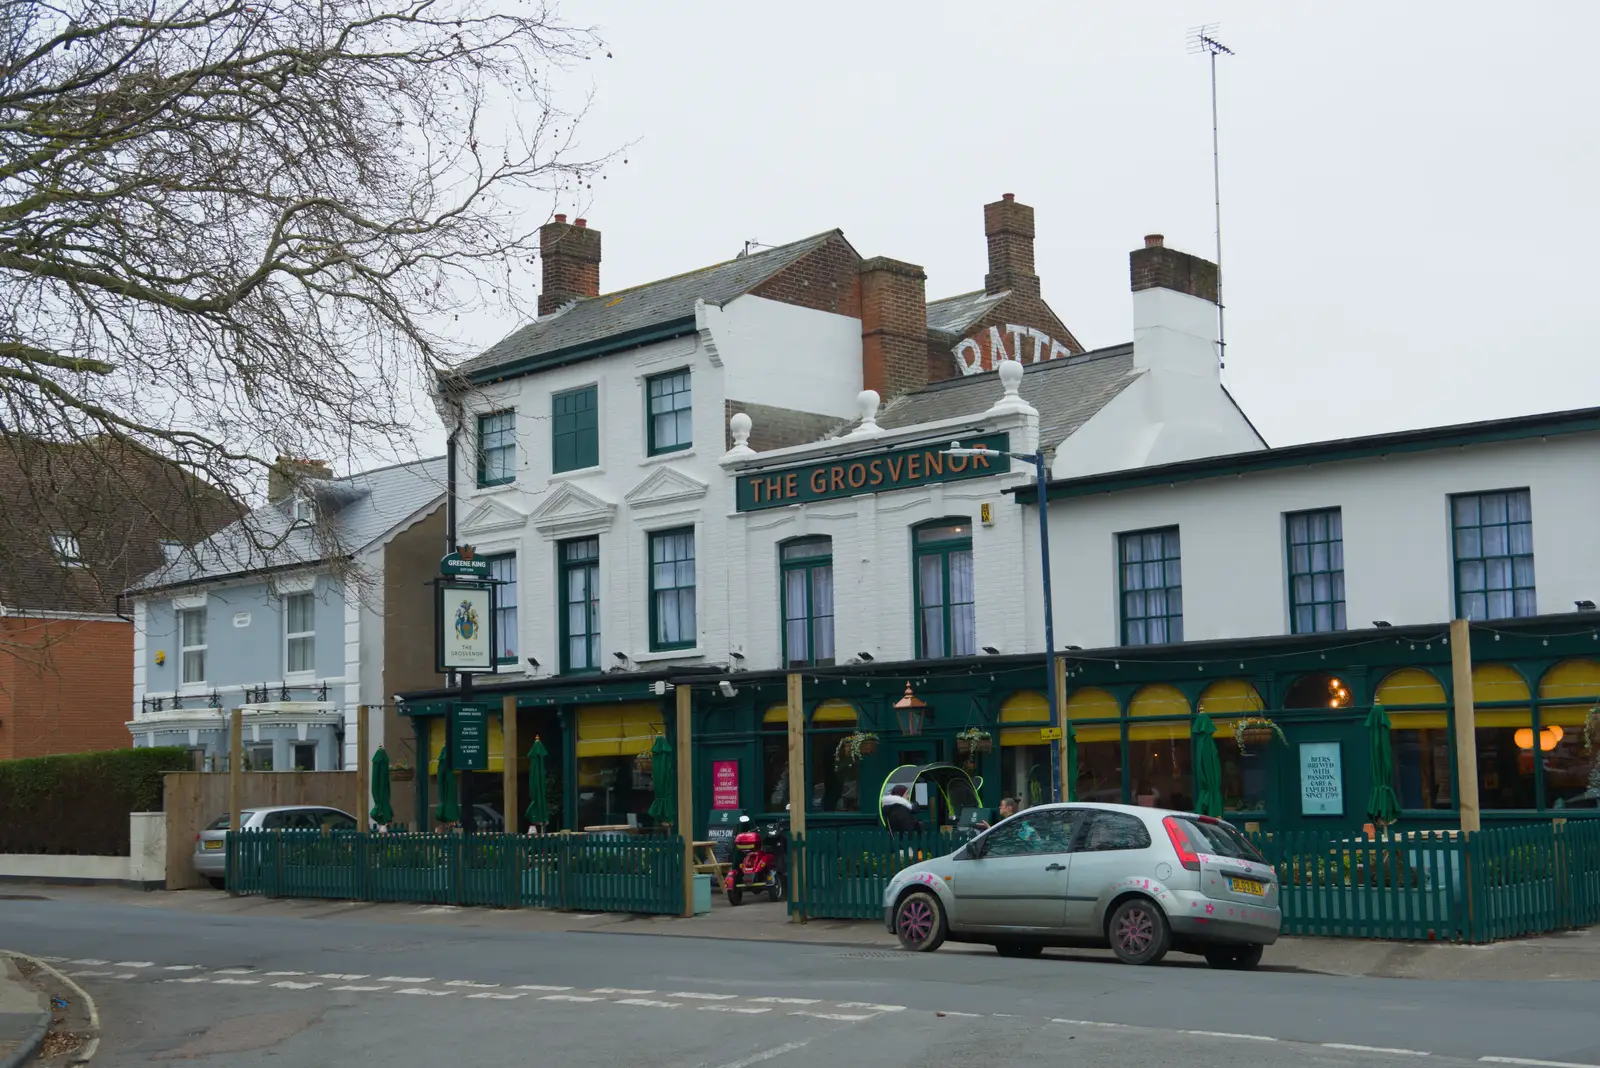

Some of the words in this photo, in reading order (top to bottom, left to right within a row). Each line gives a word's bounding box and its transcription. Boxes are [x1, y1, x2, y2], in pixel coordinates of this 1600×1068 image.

[750, 473, 798, 503] THE
[810, 443, 990, 494] GROSVENOR
[725, 829, 733, 837] ON
